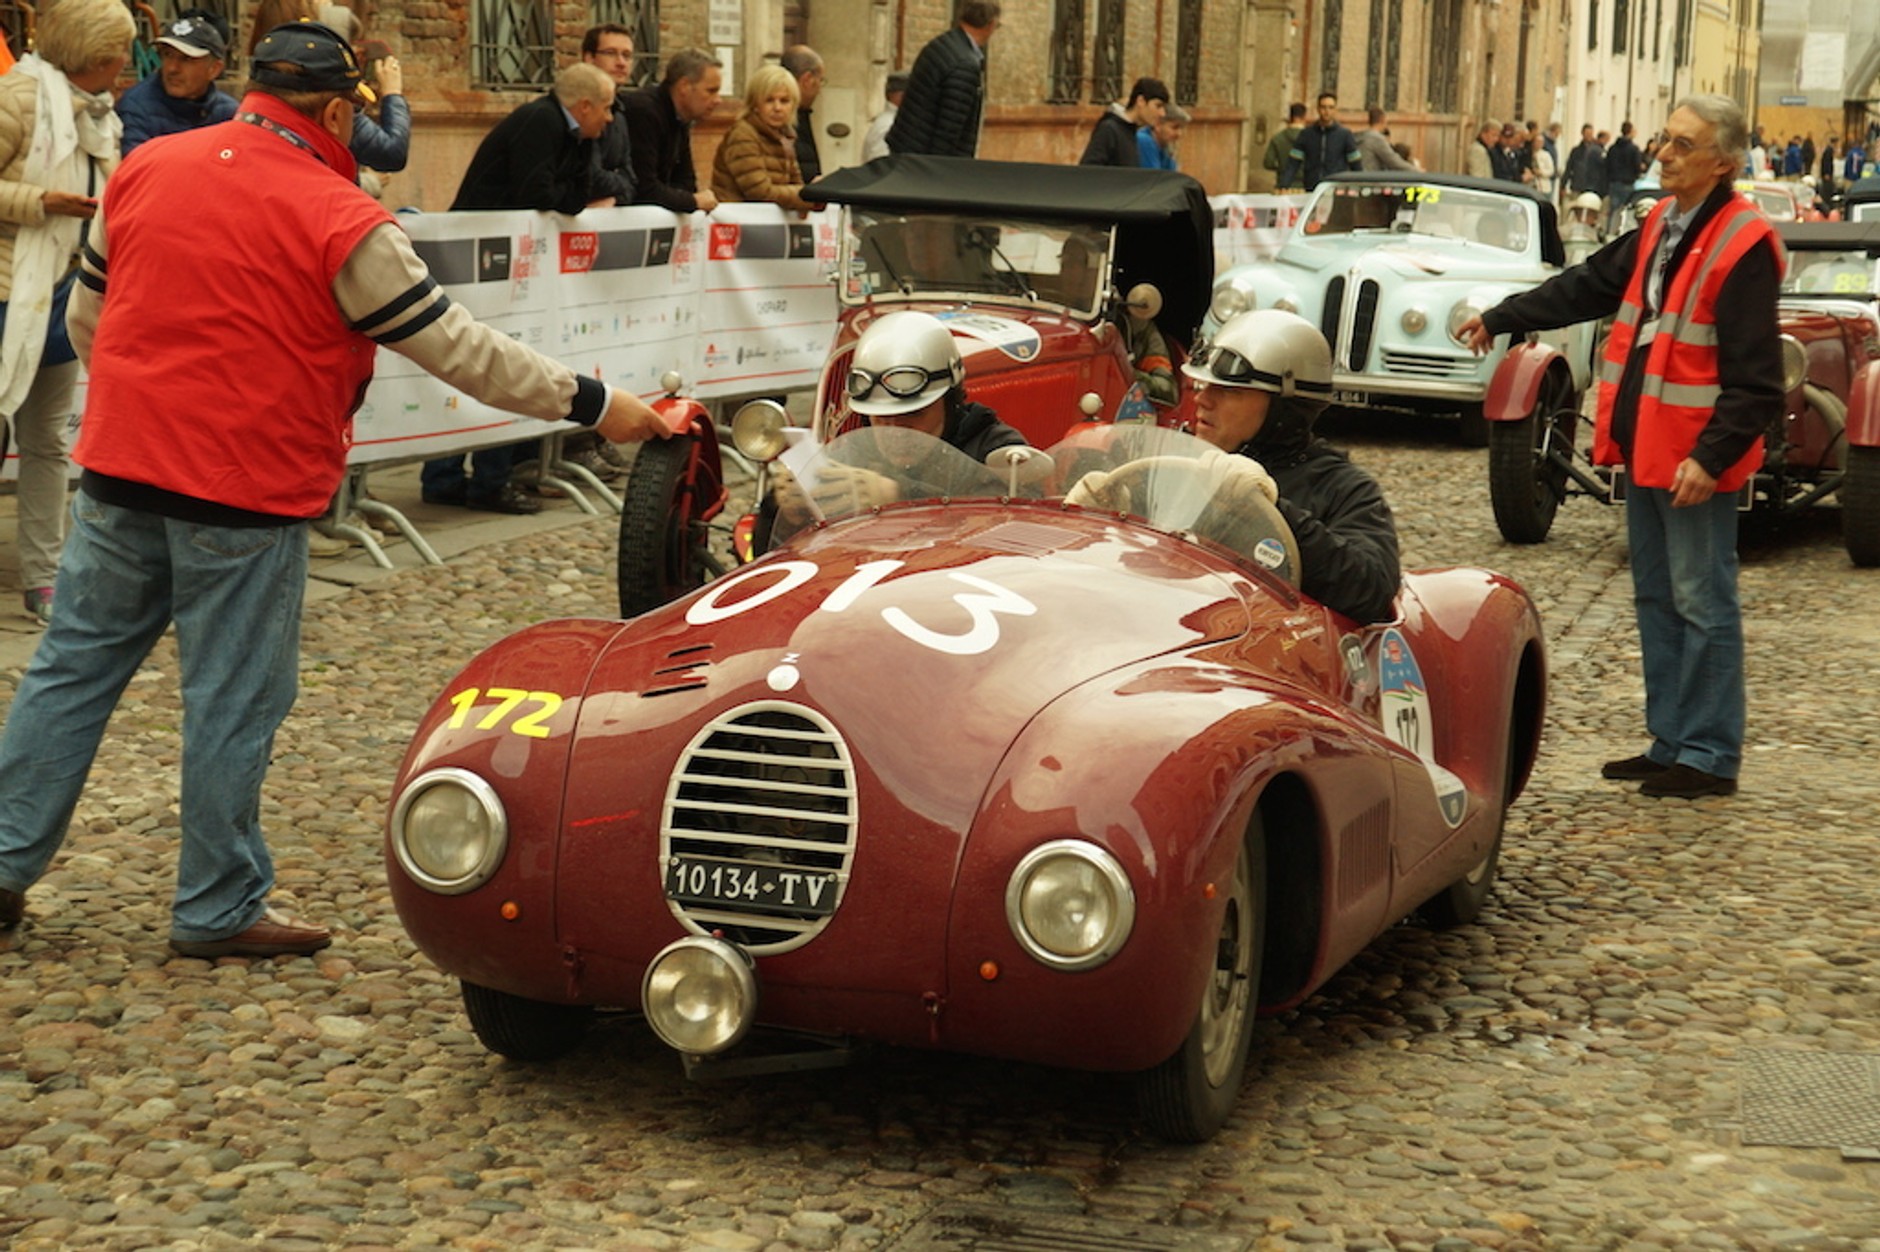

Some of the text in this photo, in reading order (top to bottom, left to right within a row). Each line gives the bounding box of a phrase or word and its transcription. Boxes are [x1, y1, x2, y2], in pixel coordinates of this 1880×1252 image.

[1404, 187, 1440, 203] 173
[568, 236, 593, 250] 1000
[1834, 272, 1868, 294] 89
[686, 559, 1038, 655] 013
[447, 687, 564, 739] 172
